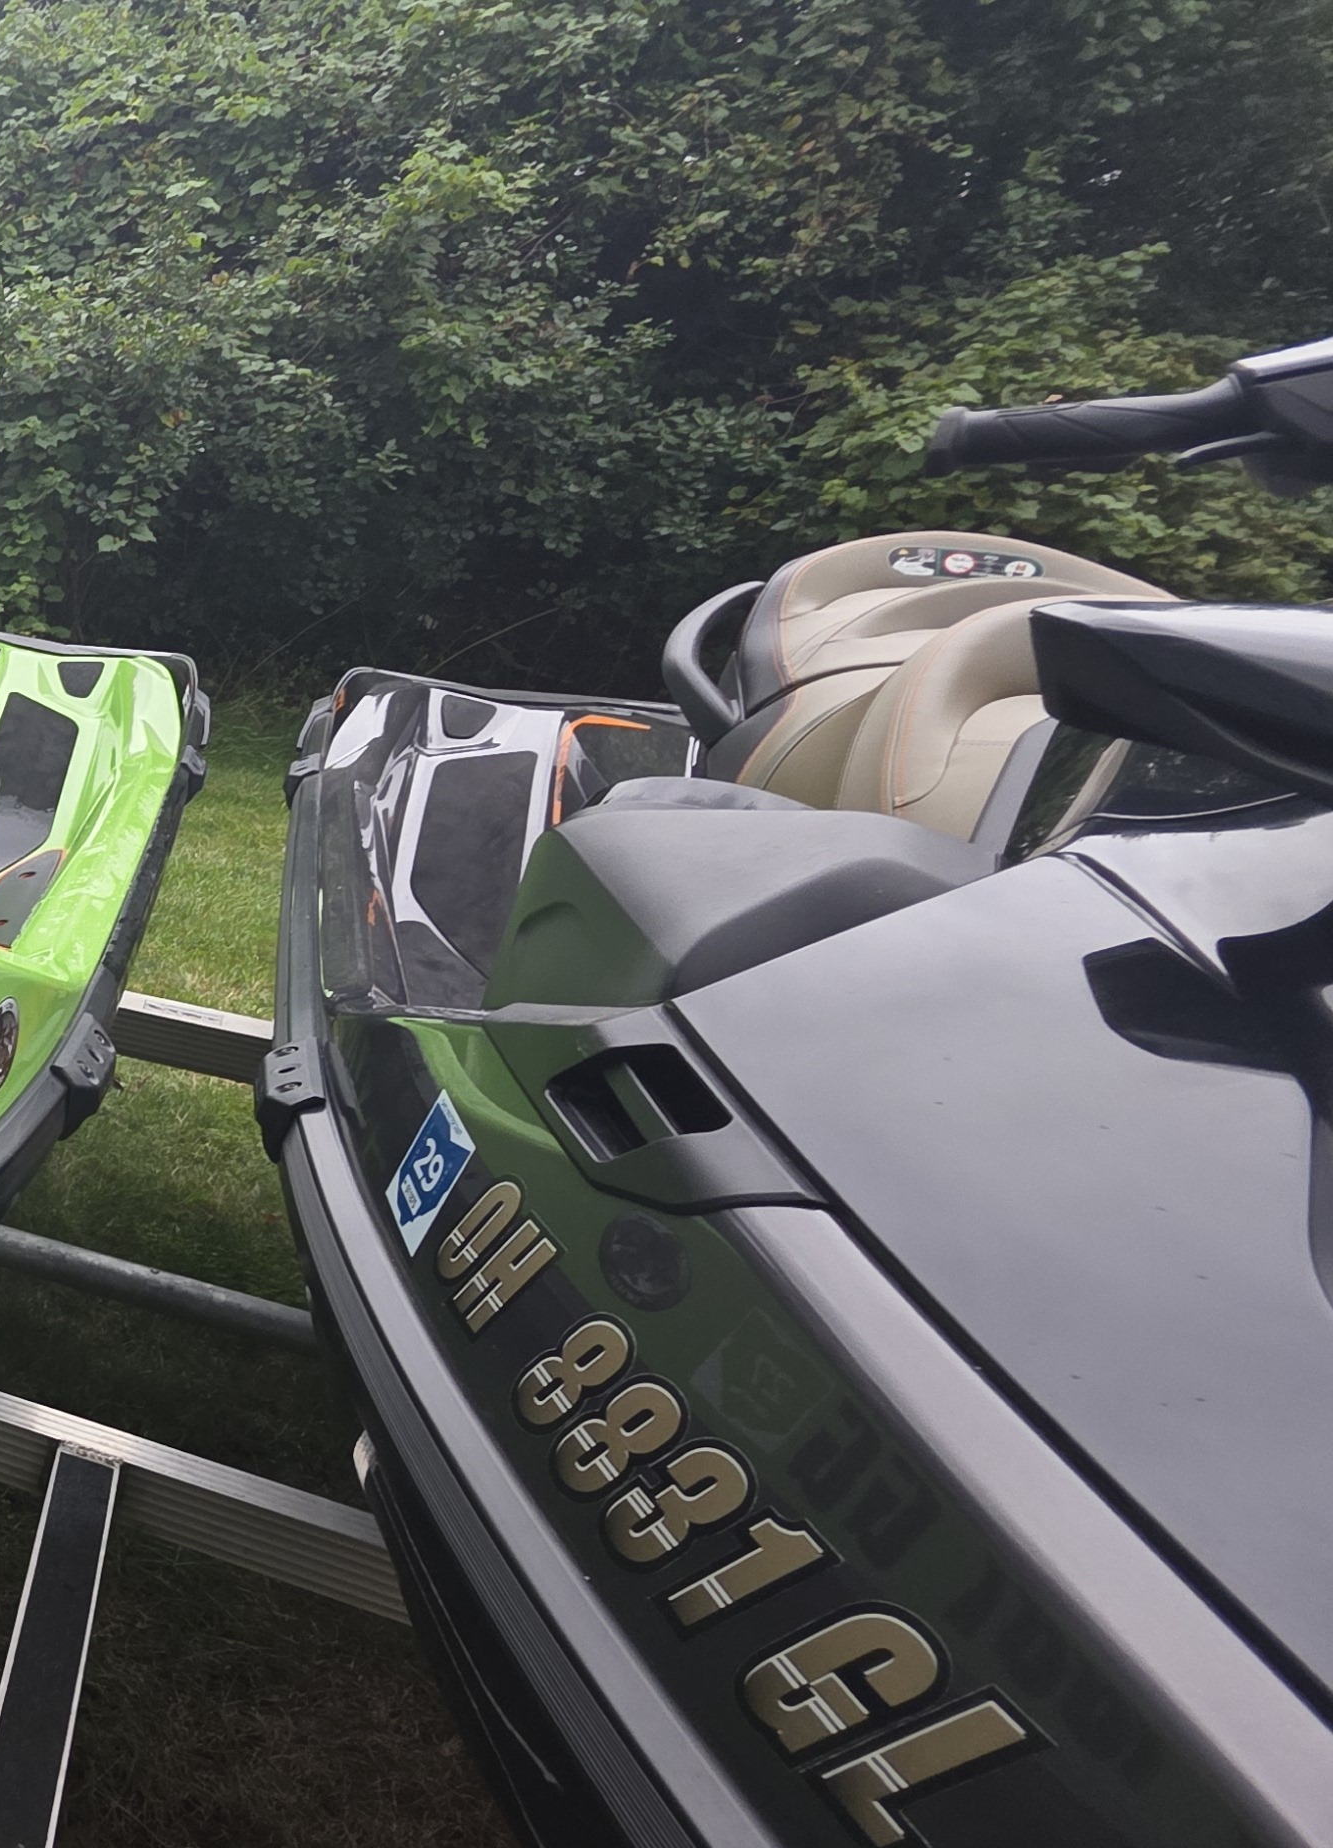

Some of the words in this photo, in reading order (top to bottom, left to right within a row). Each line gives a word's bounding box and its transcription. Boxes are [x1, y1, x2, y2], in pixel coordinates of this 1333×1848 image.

[412, 1137, 445, 1192] 29
[436, 1179, 559, 1336] OH
[515, 1318, 828, 1630] 8831
[742, 1611, 1030, 1848] GL
